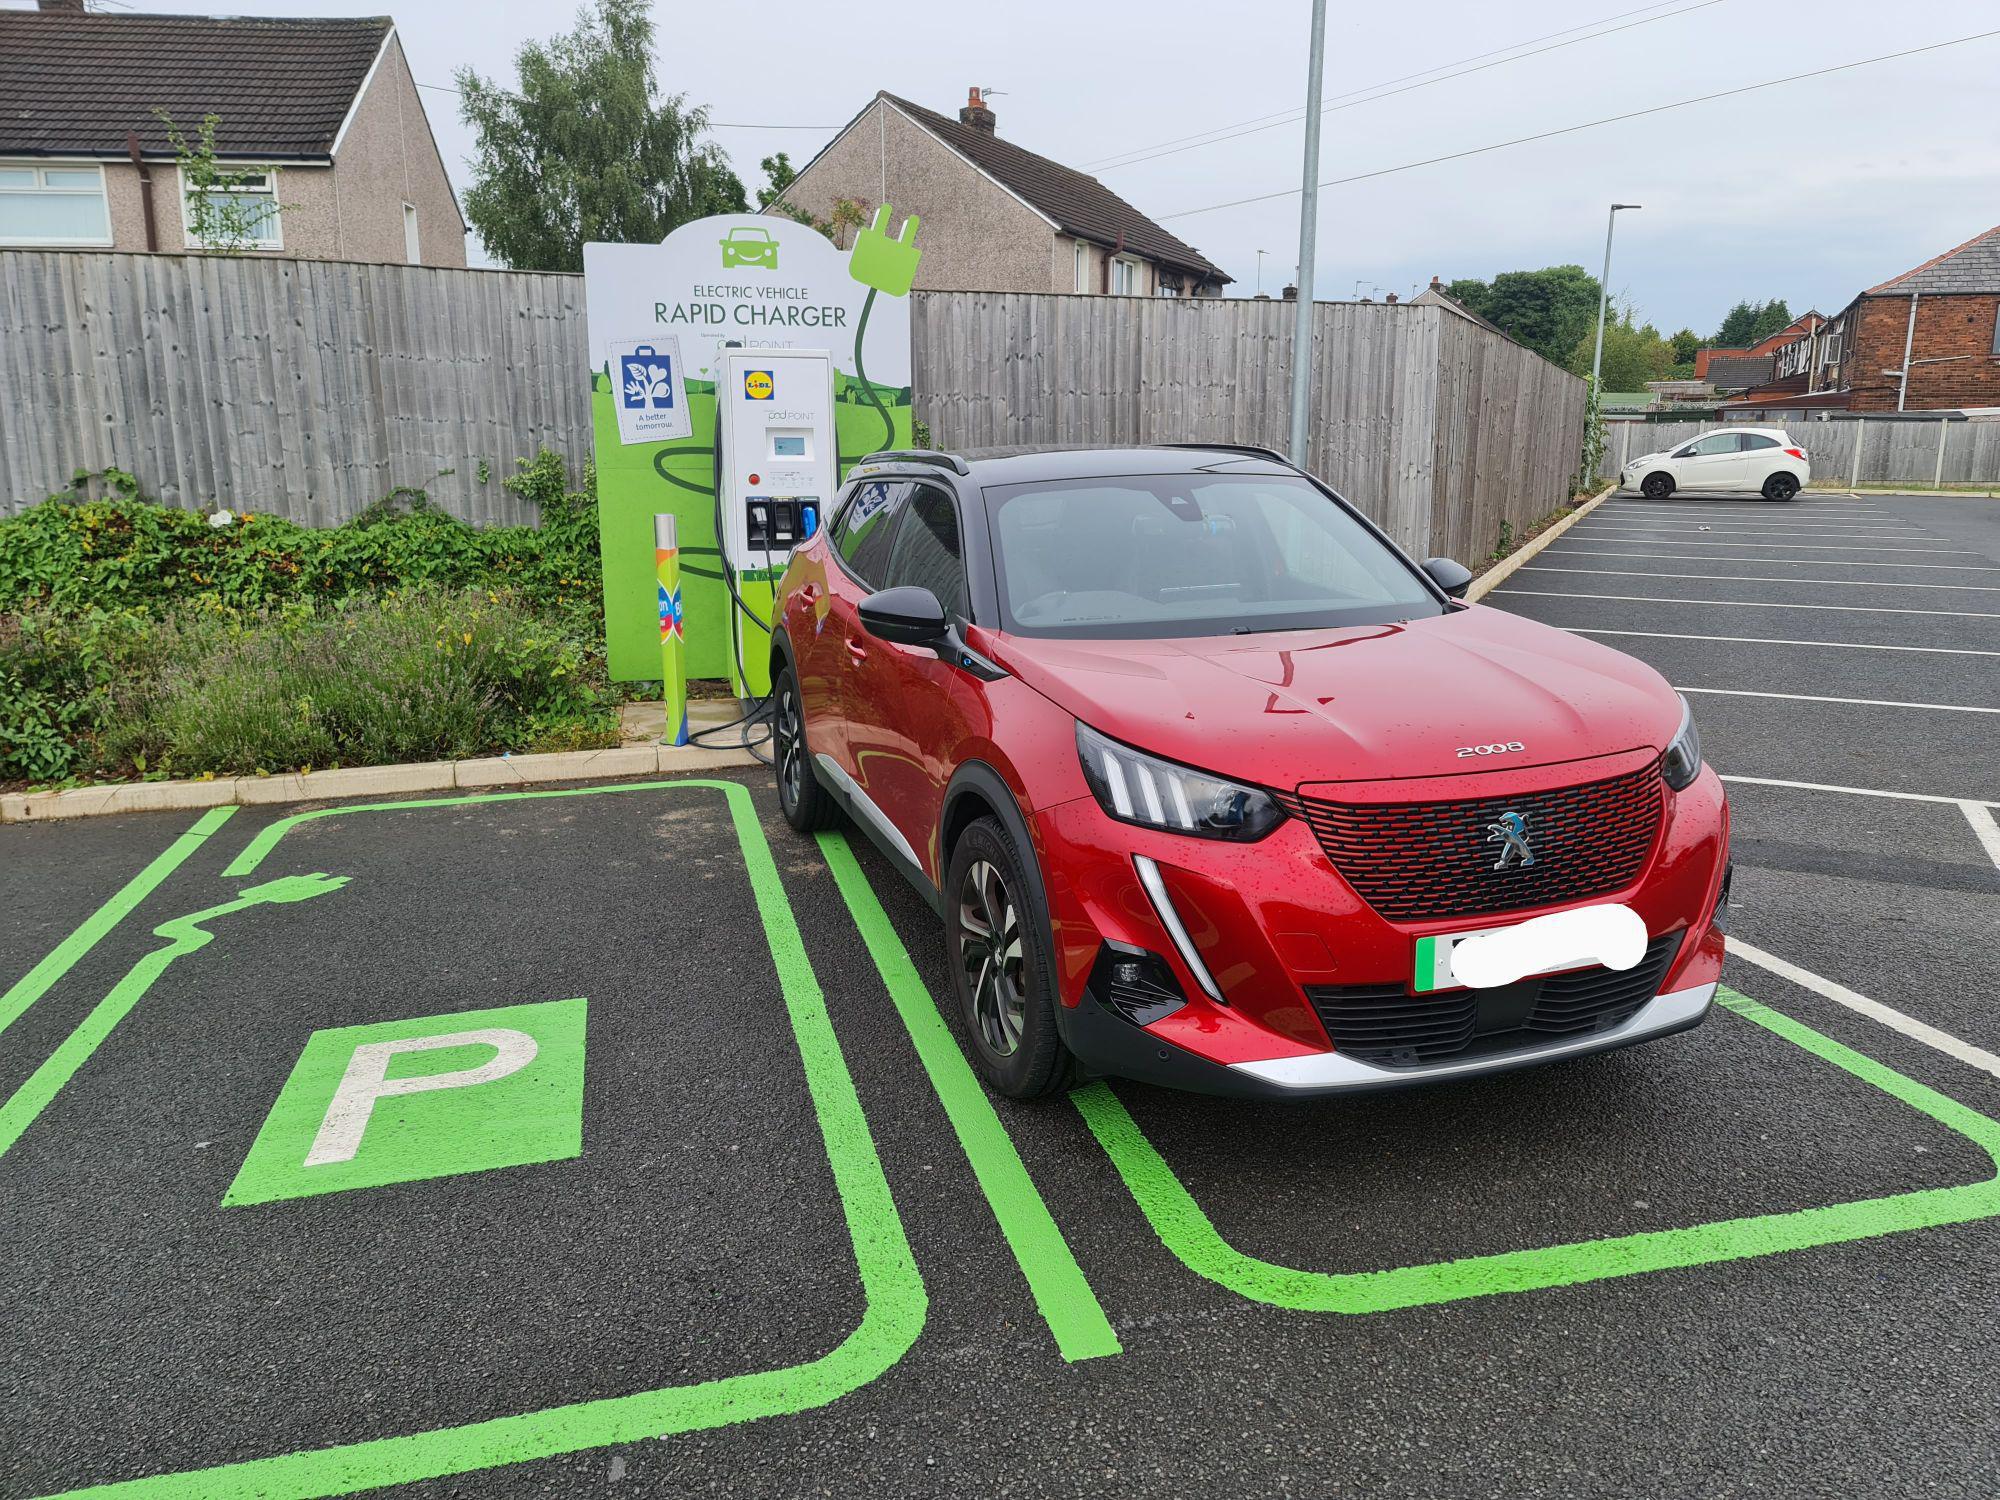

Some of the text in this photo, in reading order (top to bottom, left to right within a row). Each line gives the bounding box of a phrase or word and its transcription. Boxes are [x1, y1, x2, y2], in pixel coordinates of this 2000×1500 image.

[694, 285, 808, 300] ELECTRIC VEHICLE
[654, 302, 847, 327] RAPID CHARGER
[645, 413, 666, 421] better
[768, 409, 815, 421] pod POINT
[1455, 741, 1525, 758] 2008
[303, 1028, 538, 1167] P
